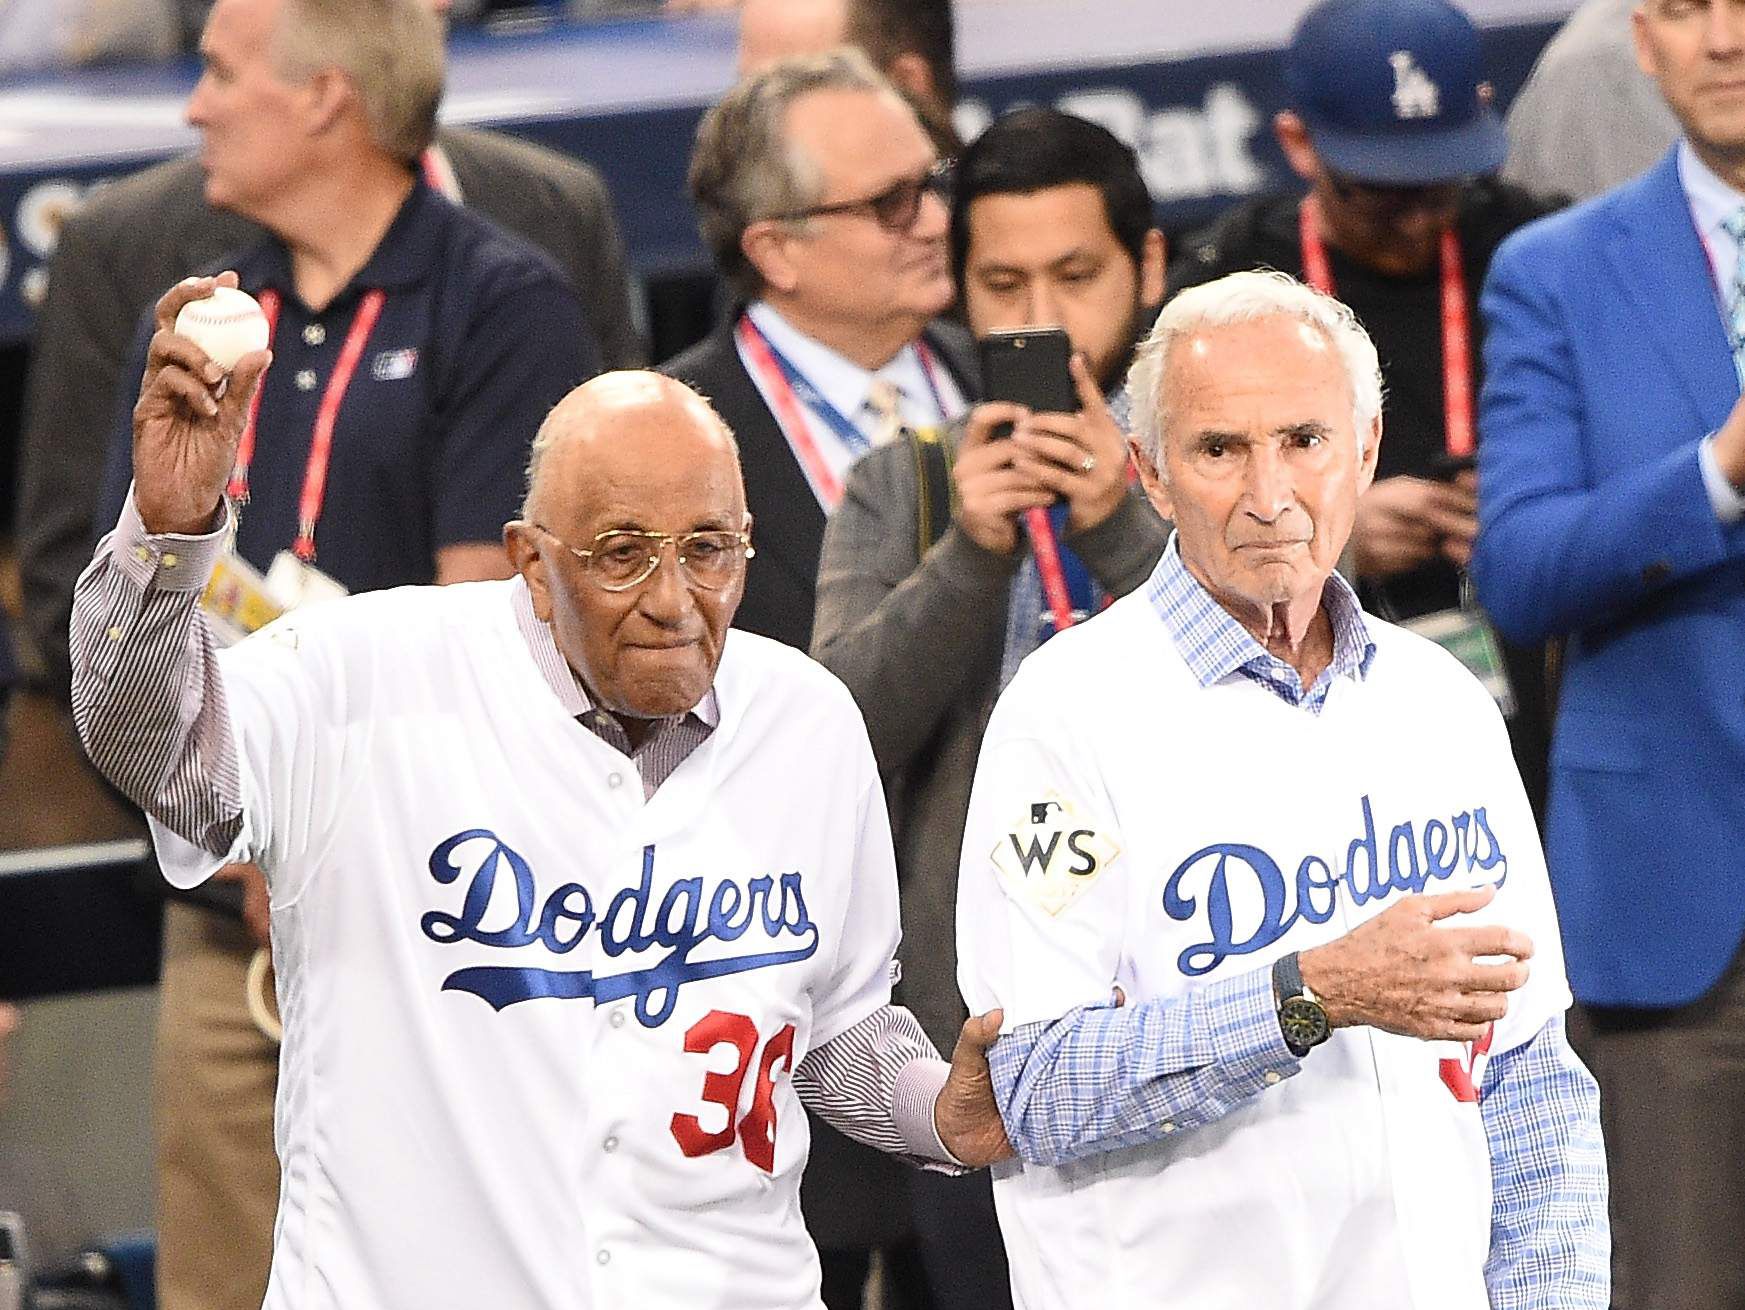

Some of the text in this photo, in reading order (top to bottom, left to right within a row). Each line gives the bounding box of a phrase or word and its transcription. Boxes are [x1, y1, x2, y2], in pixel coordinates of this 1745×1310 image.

[1388, 49, 1440, 118] LA
[1009, 829, 1096, 878] WS
[1162, 794, 1507, 976] Dodgers
[420, 828, 819, 1028] Dodgers
